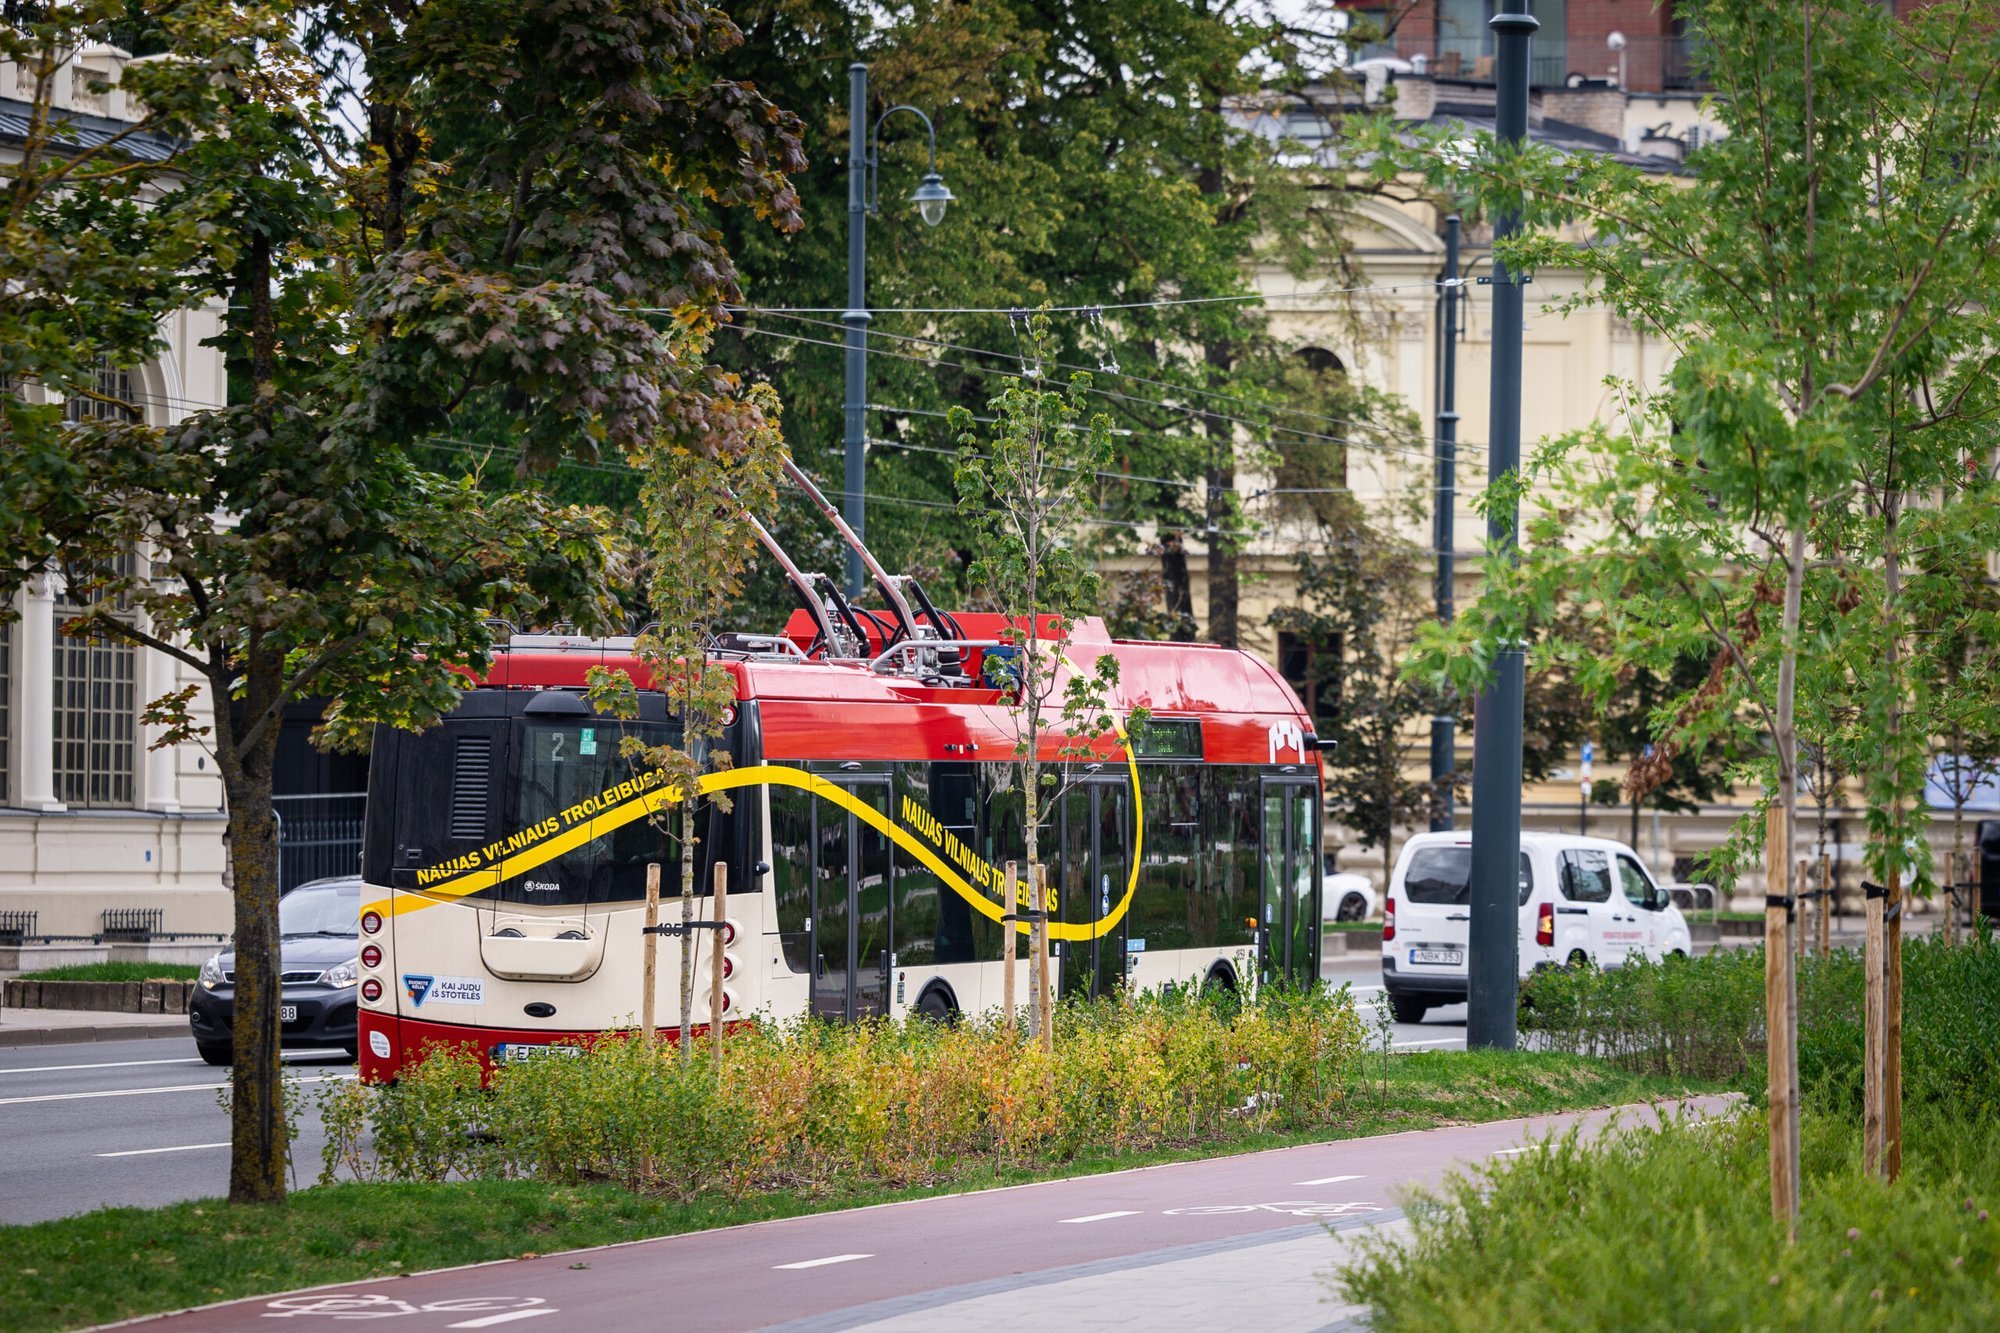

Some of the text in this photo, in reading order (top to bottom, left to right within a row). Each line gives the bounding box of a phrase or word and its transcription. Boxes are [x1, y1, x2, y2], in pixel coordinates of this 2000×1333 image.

[552, 732, 564, 762] 2
[416, 767, 679, 886] NAUJAS VILNIAUS TROLEIBUSA
[902, 794, 943, 848] NAUJAS
[944, 828, 991, 887] VILNIAUS
[535, 881, 560, 891] ŠKODA
[1441, 951, 1460, 962] 353
[441, 982, 481, 992] KAI JUDU
[431, 988, 481, 1000] IŠ STOTELĖS
